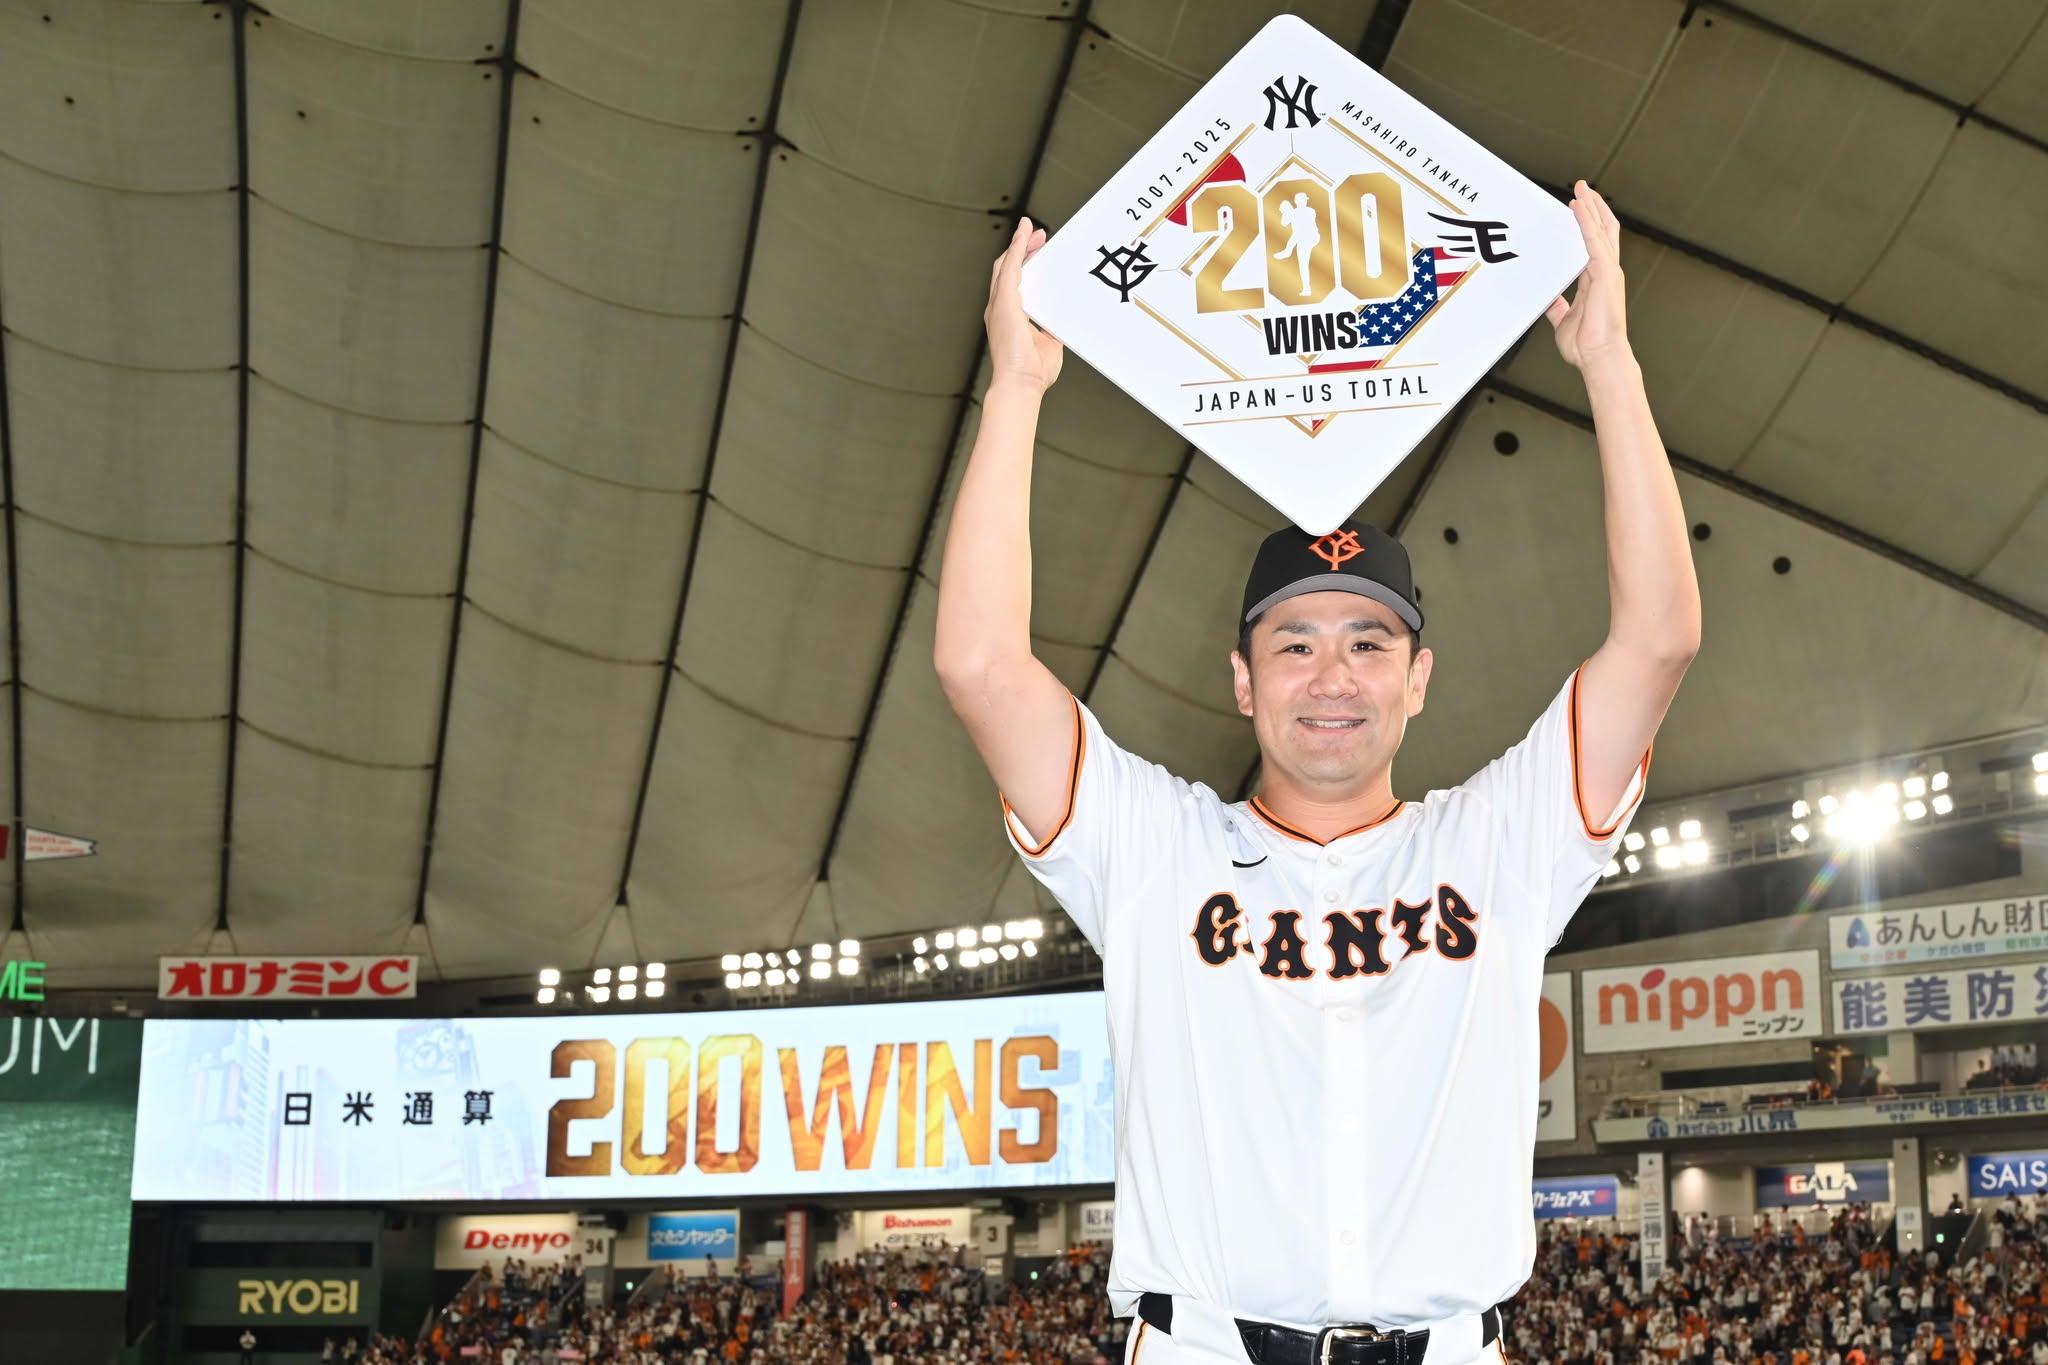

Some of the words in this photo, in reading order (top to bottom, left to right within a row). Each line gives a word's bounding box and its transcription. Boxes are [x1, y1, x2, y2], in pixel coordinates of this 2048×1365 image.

[1126, 118, 1231, 221] 2007-2025
[1341, 101, 1417, 158] MASAHIRO
[1422, 157, 1479, 203] TANAKA
[1191, 171, 1409, 314] 200
[1262, 311, 1358, 355] WINS
[1348, 376, 1428, 399] TOTAL
[1189, 883, 1479, 982] GANTS
[166, 959, 410, 996] オロナミンC
[1598, 968, 1804, 1031] nippn
[1743, 1015, 1804, 1036] ニップン
[285, 1089, 495, 1126] 日米通算
[545, 1033, 763, 1177] 200
[776, 1035, 1059, 1172] WINS
[1790, 1173, 1858, 1195] GALA
[1981, 1161, 2047, 1191] SAIS
[464, 1229, 571, 1255] Denyo
[585, 1238, 603, 1254] 34
[987, 1227, 999, 1243] 3
[238, 1279, 359, 1314] RYOBI
